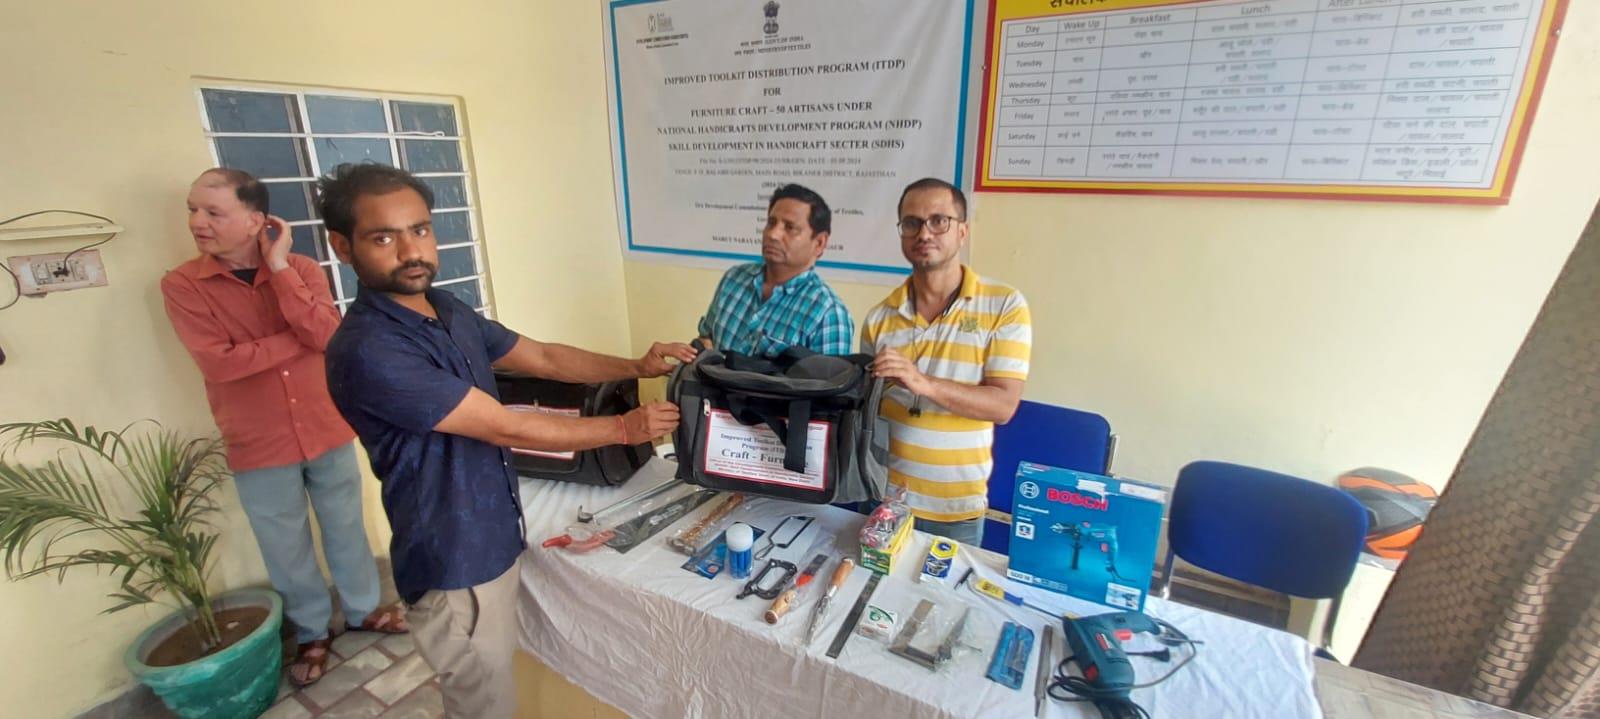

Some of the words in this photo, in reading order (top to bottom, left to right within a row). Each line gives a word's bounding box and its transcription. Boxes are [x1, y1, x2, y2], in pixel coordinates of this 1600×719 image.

[1241, 5, 1271, 15] Lunch
[1130, 13, 1171, 25] Breakfast
[1025, 26, 1040, 34] Day
[1064, 22, 1086, 30] Wake
[1088, 20, 1101, 30] Up
[1017, 40, 1045, 49] Monday
[1016, 59, 1043, 68] Tuesday
[664, 73, 707, 86] IMPROVED
[709, 70, 745, 83] TOOLKIT
[747, 65, 814, 80] DISTRIBUTION
[817, 60, 869, 75] PROGRAM
[871, 58, 905, 72] (ITDP)
[1008, 80, 1047, 90] Wednesday
[763, 87, 781, 96] FOR
[1011, 96, 1041, 106] Thursday
[691, 107, 737, 118] FURNITURE
[738, 105, 768, 116] CRAFT
[787, 103, 835, 114] ARTISANS
[837, 101, 873, 112] UNDER
[1014, 111, 1035, 121] Friday
[656, 126, 697, 136] NATIONAL
[698, 123, 756, 135] HANDICRAFTS
[758, 121, 827, 133] DEVELOPMENT
[830, 120, 882, 131] PROGRAM
[885, 119, 922, 130] (NHDP)
[1007, 132, 1036, 141] Saturday
[668, 142, 691, 152] SKILL
[692, 141, 754, 151] DEVELOPMENT
[755, 141, 765, 150] IN
[766, 140, 828, 150] HANDICRAFT
[830, 139, 869, 150] SECTER
[871, 139, 905, 151] (SDHS)
[1007, 157, 1031, 166] Sunday
[720, 433, 752, 442] Improved
[741, 442, 769, 453] Program
[721, 448, 749, 460] Craft
[1047, 487, 1108, 511] BOSCH
